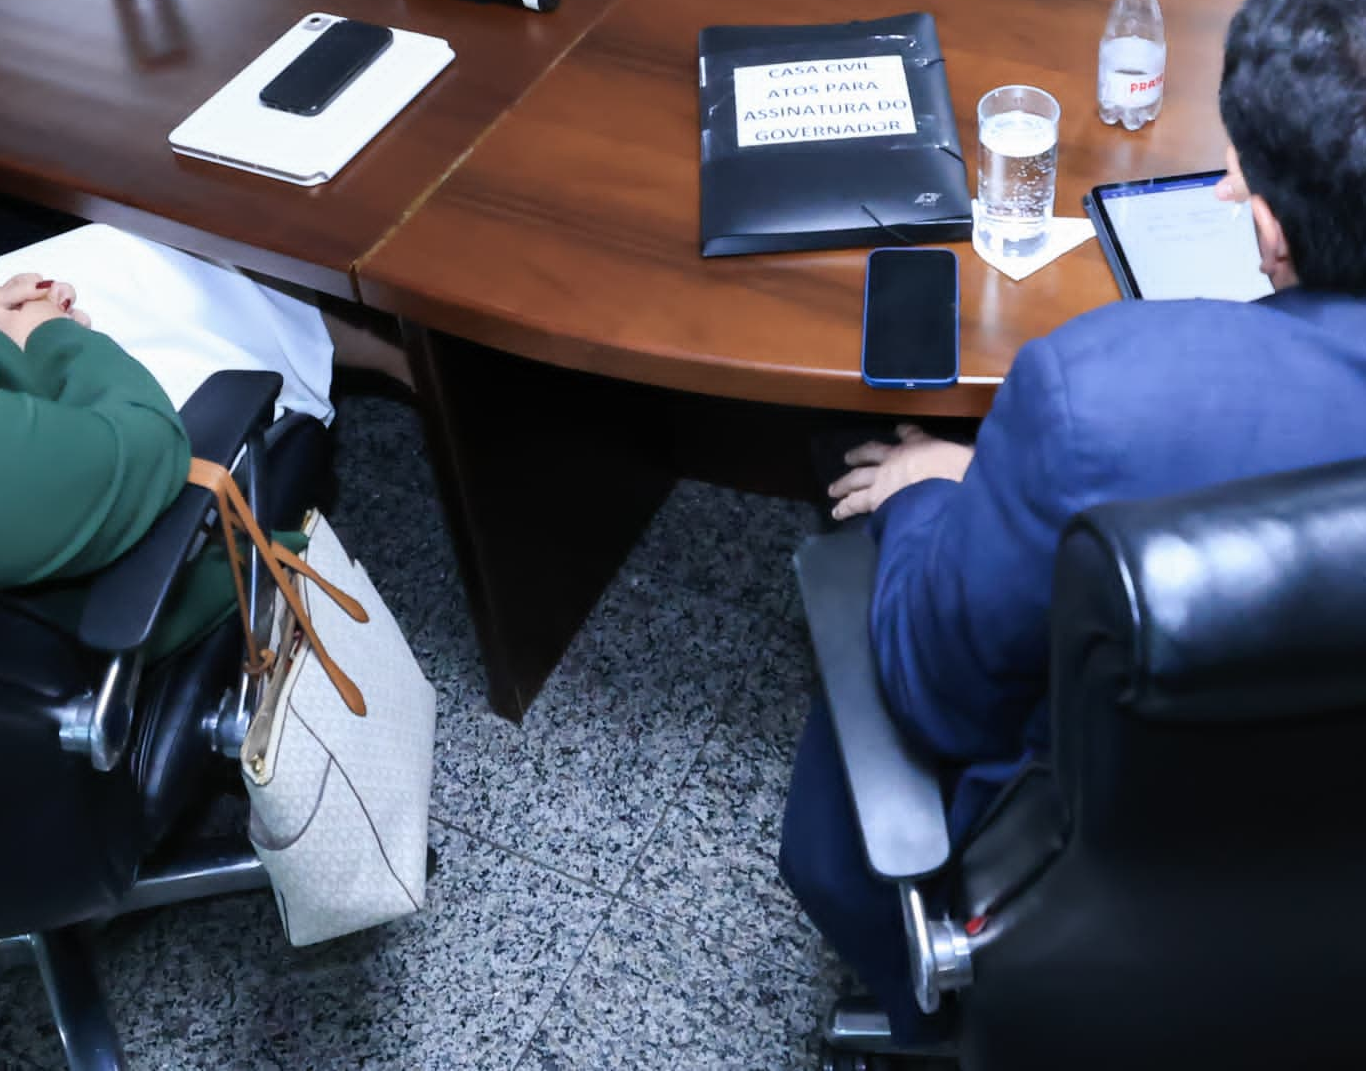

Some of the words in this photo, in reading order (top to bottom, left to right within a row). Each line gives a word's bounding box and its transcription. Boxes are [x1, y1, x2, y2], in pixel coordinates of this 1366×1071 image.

[768, 65, 818, 78] CASA
[825, 62, 871, 74] CIVIL
[767, 84, 819, 99] ATOS
[826, 81, 879, 93] PARA
[744, 102, 871, 121] ASSINATURA
[878, 99, 907, 111] DO
[755, 121, 900, 141] GOVERNADOR
